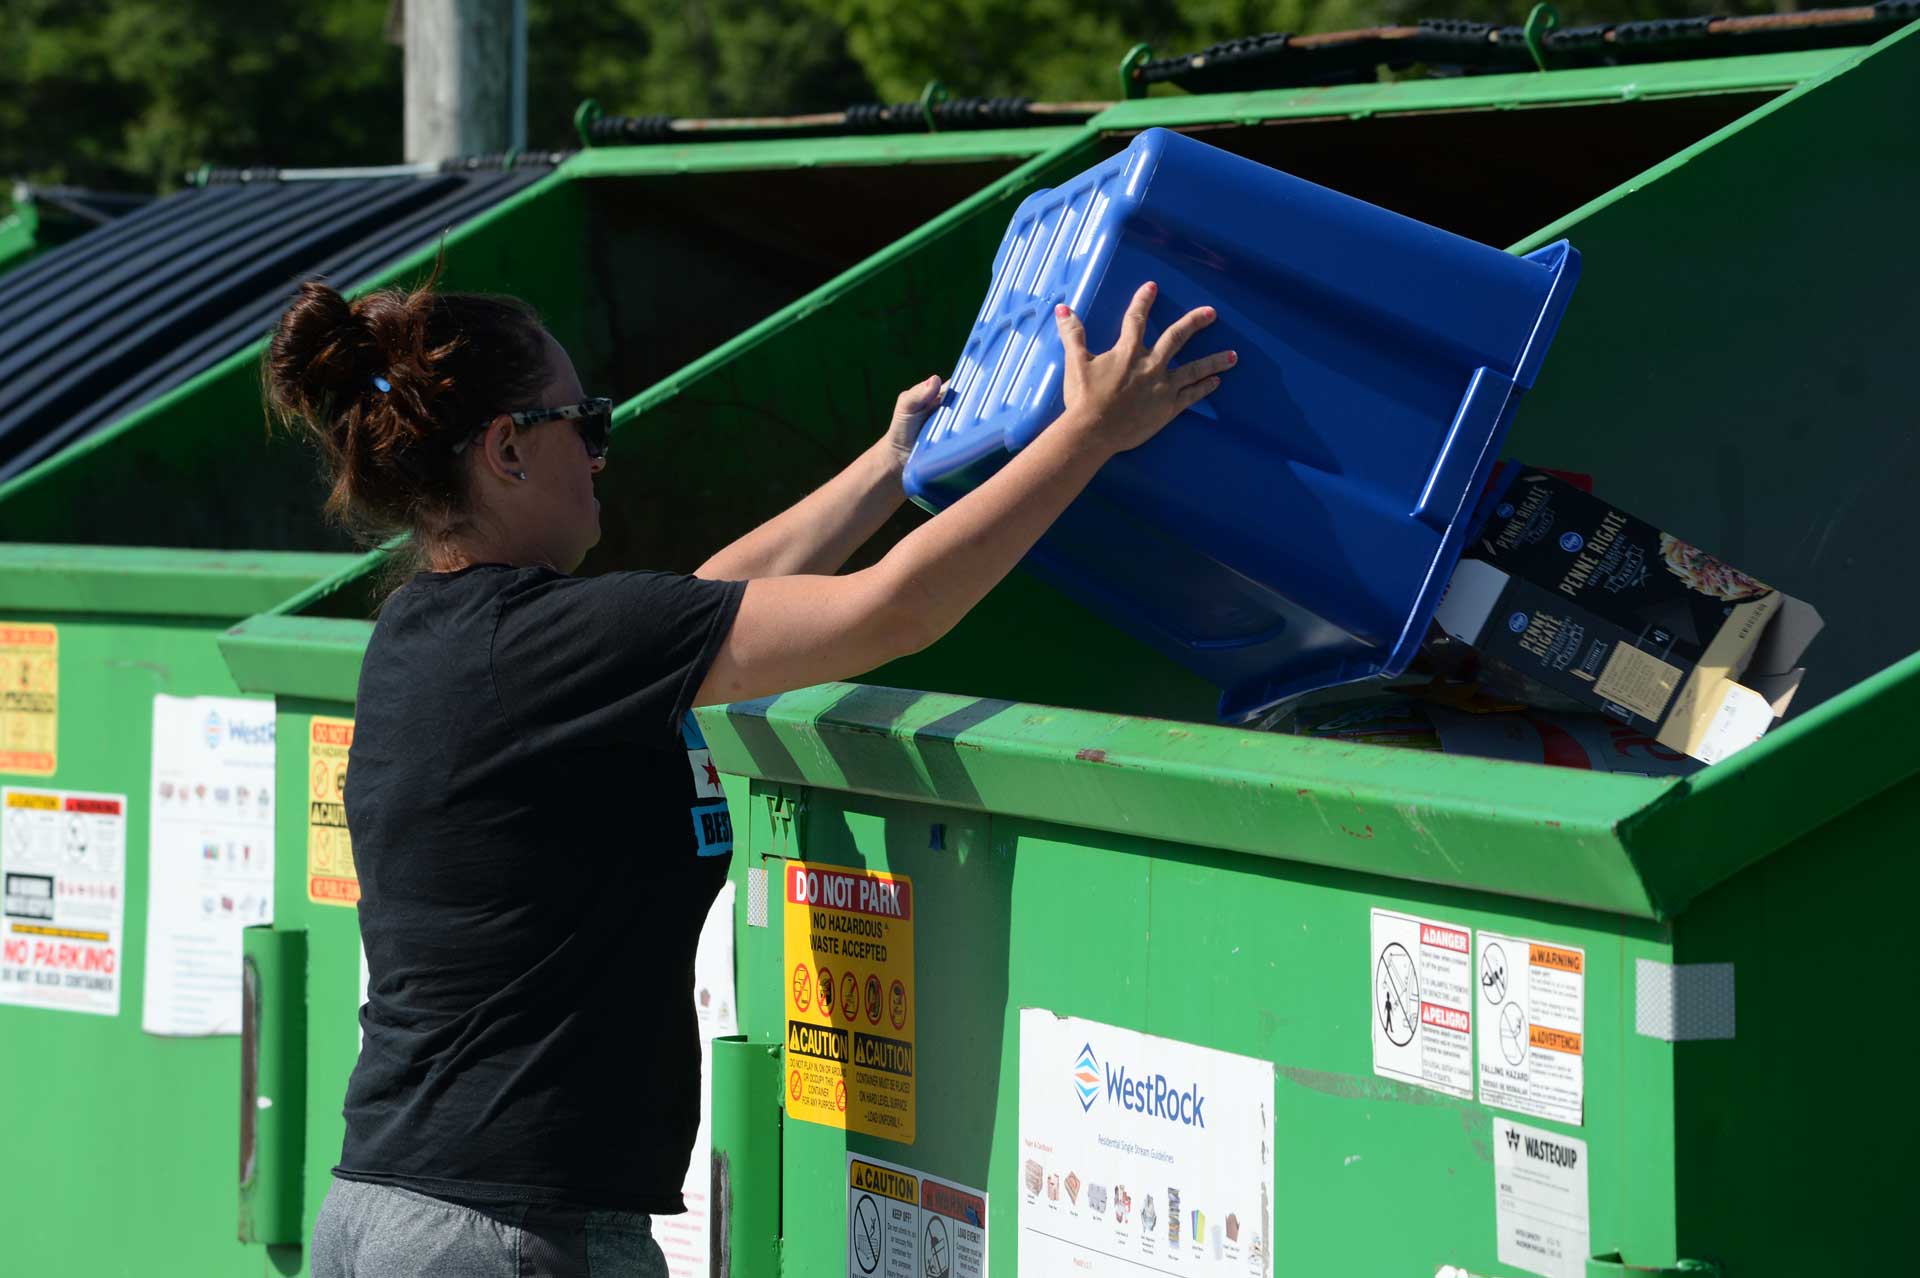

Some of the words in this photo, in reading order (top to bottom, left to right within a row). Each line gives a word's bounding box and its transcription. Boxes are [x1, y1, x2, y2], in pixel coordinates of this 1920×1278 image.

[1558, 551, 1600, 597] PENNE
[1586, 510, 1628, 556] RIGATE
[1519, 609, 1553, 652] PENNE
[1532, 618, 1562, 657] RIGATE
[796, 870, 819, 904] DO
[823, 874, 855, 909] NOT
[859, 879, 902, 916] PARK
[813, 911, 826, 930] NO
[828, 915, 883, 939] HAZARDOUS
[1430, 930, 1467, 950] DANGER
[4, 940, 28, 965] NO
[34, 941, 115, 974] PARKING
[810, 934, 839, 955] WASTE
[842, 939, 887, 962] ACCEPTED
[1537, 949, 1580, 970] WARNING
[1430, 1007, 1467, 1031] PELIGRO
[800, 1027, 848, 1060] CAUTION
[865, 1040, 912, 1073] CAUTION
[1105, 1061, 1205, 1128] WestRock
[1098, 1133, 1121, 1150] Residential
[1121, 1140, 1134, 1155] Single
[1150, 1148, 1174, 1165] Guidelines
[1525, 1135, 1577, 1170] WASTEQUIP
[865, 1168, 914, 1201] CAUTION
